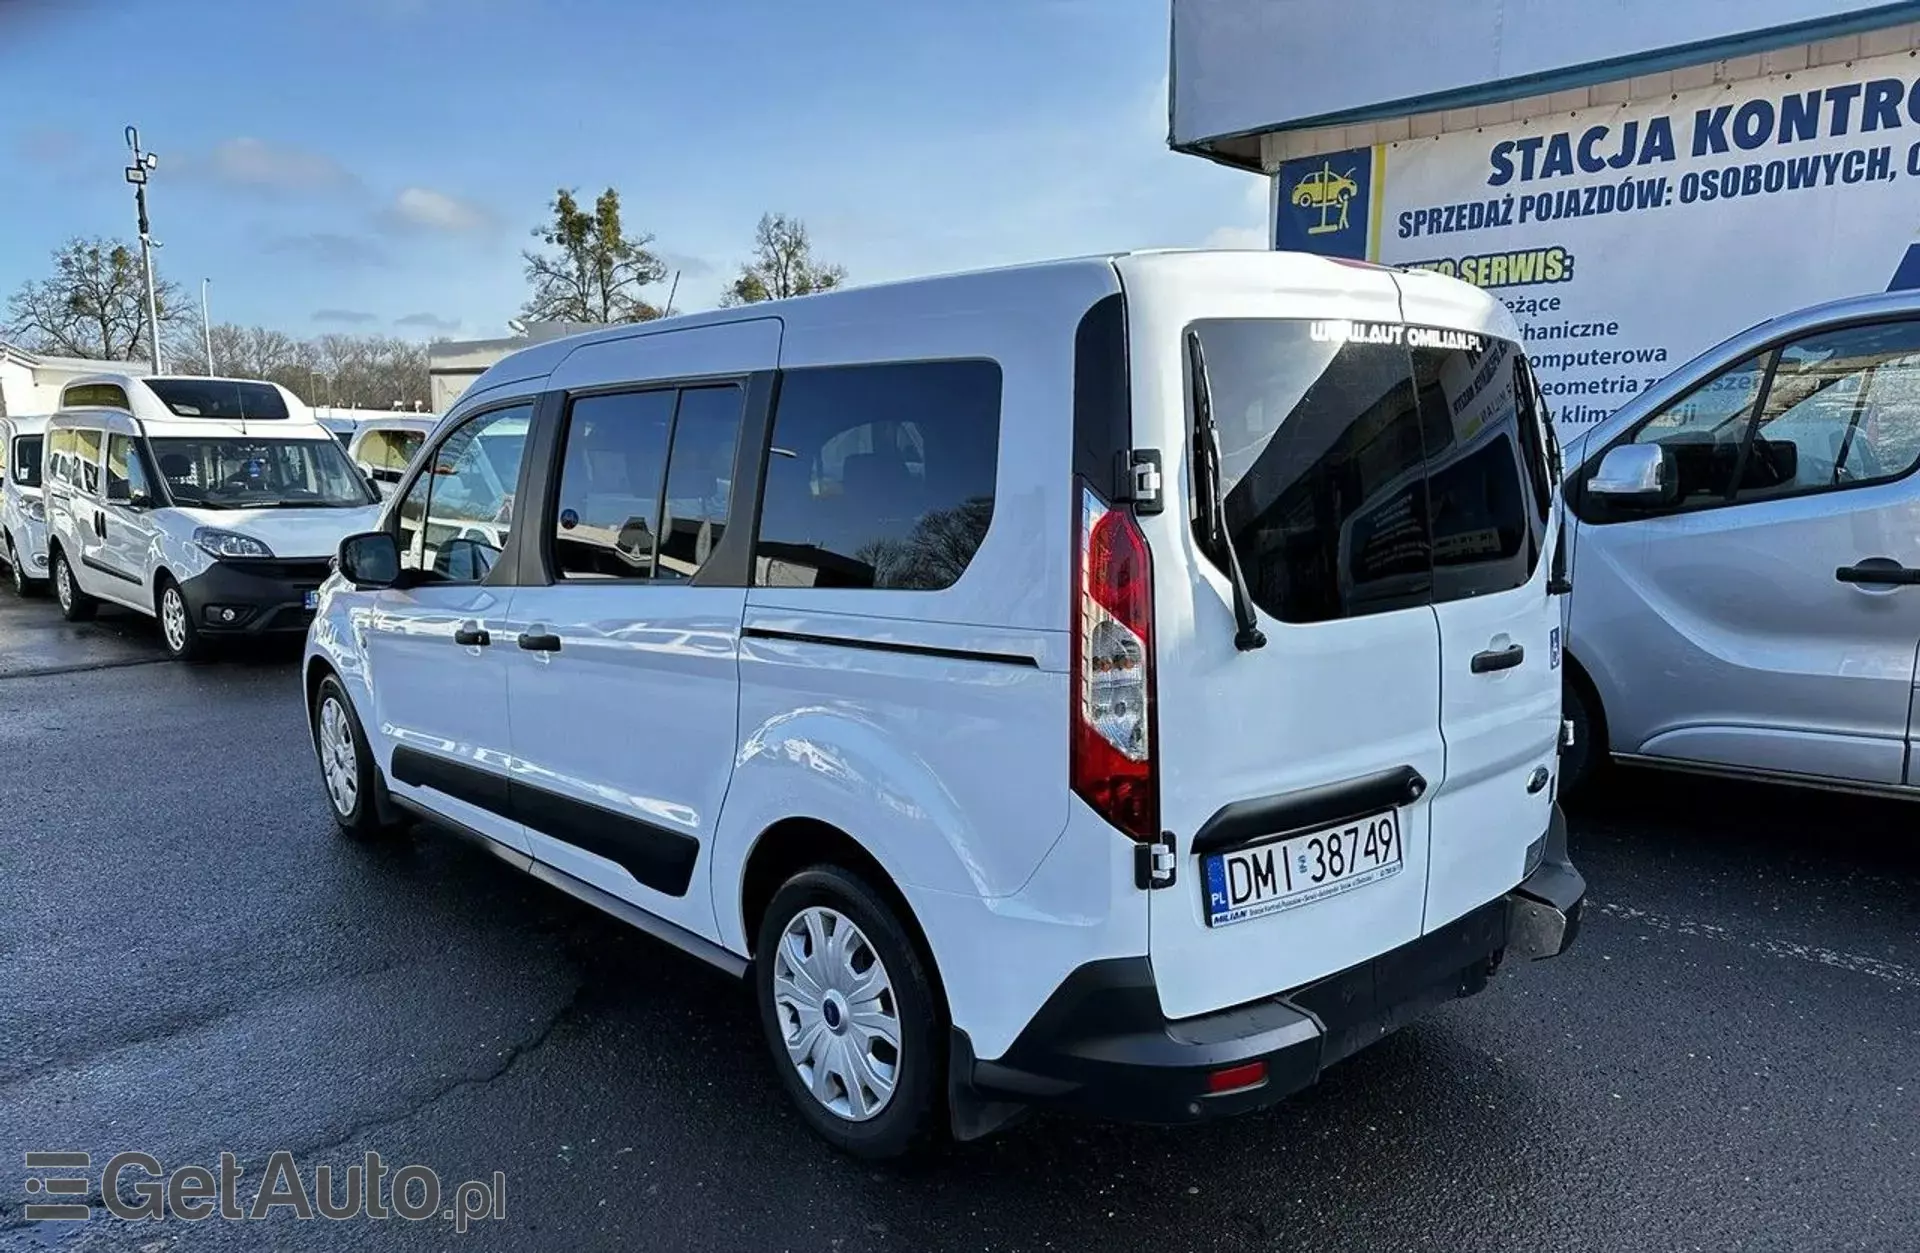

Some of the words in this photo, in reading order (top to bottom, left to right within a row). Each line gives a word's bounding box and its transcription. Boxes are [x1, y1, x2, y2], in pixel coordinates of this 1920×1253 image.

[1487, 116, 1676, 186] STACJA
[1398, 196, 1512, 238] SPRZEDAŻ
[1518, 176, 1673, 223] POJAZDÓW:
[1680, 146, 1897, 203] OSOBOWYCH,
[1499, 296, 1561, 318] eżące
[1520, 319, 1619, 341] haniczne
[1530, 347, 1668, 372] omputerowa
[1540, 374, 1638, 397] eometria
[1229, 846, 1292, 905] DMI
[1308, 818, 1392, 882] 38749
[1211, 892, 1226, 906] PL
[1213, 910, 1248, 924] MILIAN
